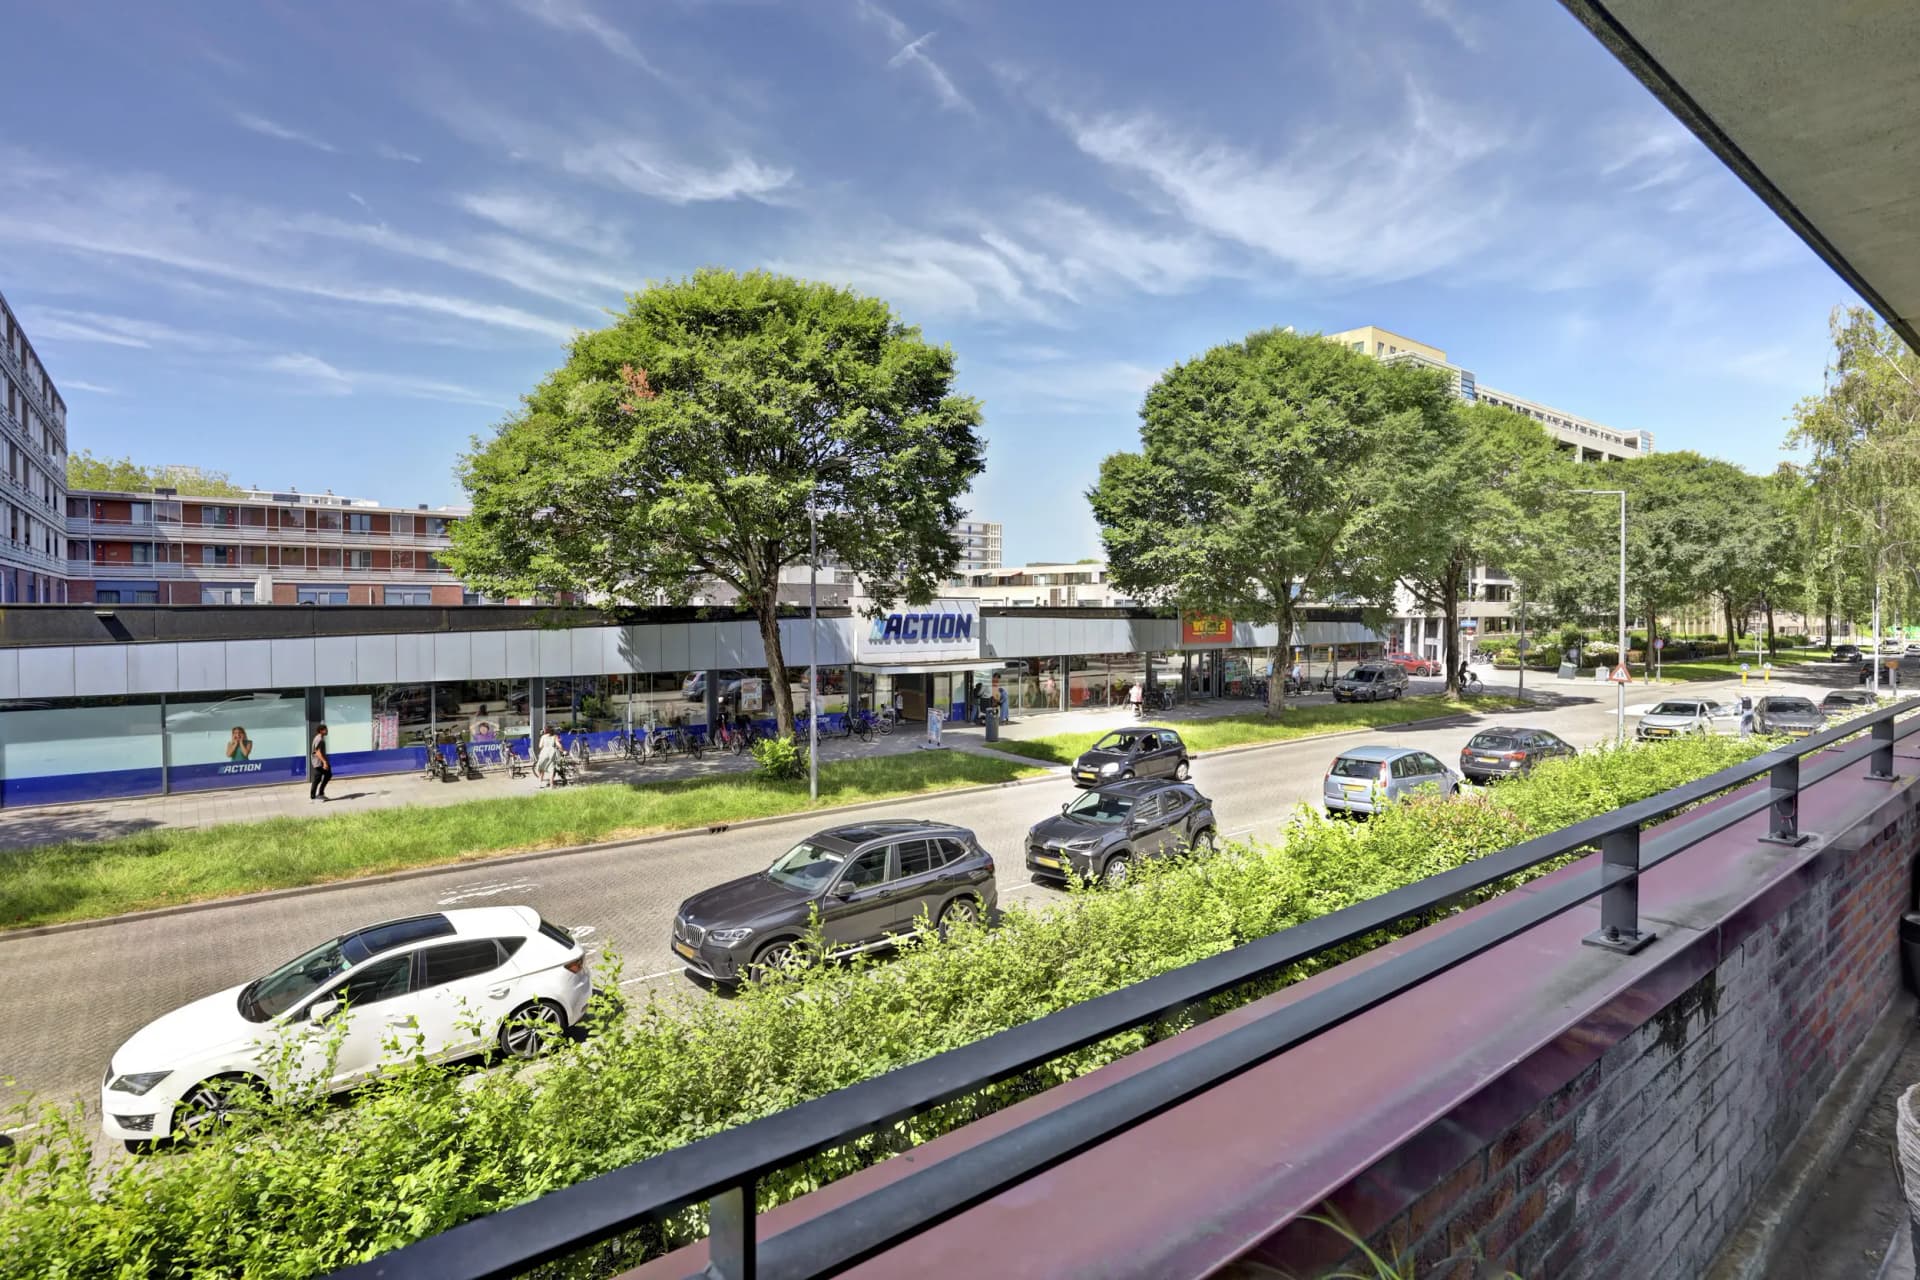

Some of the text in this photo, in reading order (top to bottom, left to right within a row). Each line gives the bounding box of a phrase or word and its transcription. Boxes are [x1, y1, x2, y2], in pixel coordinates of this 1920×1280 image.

[882, 613, 973, 641] ACTION
[473, 743, 502, 753] ACTION
[223, 762, 262, 774] ACTION
